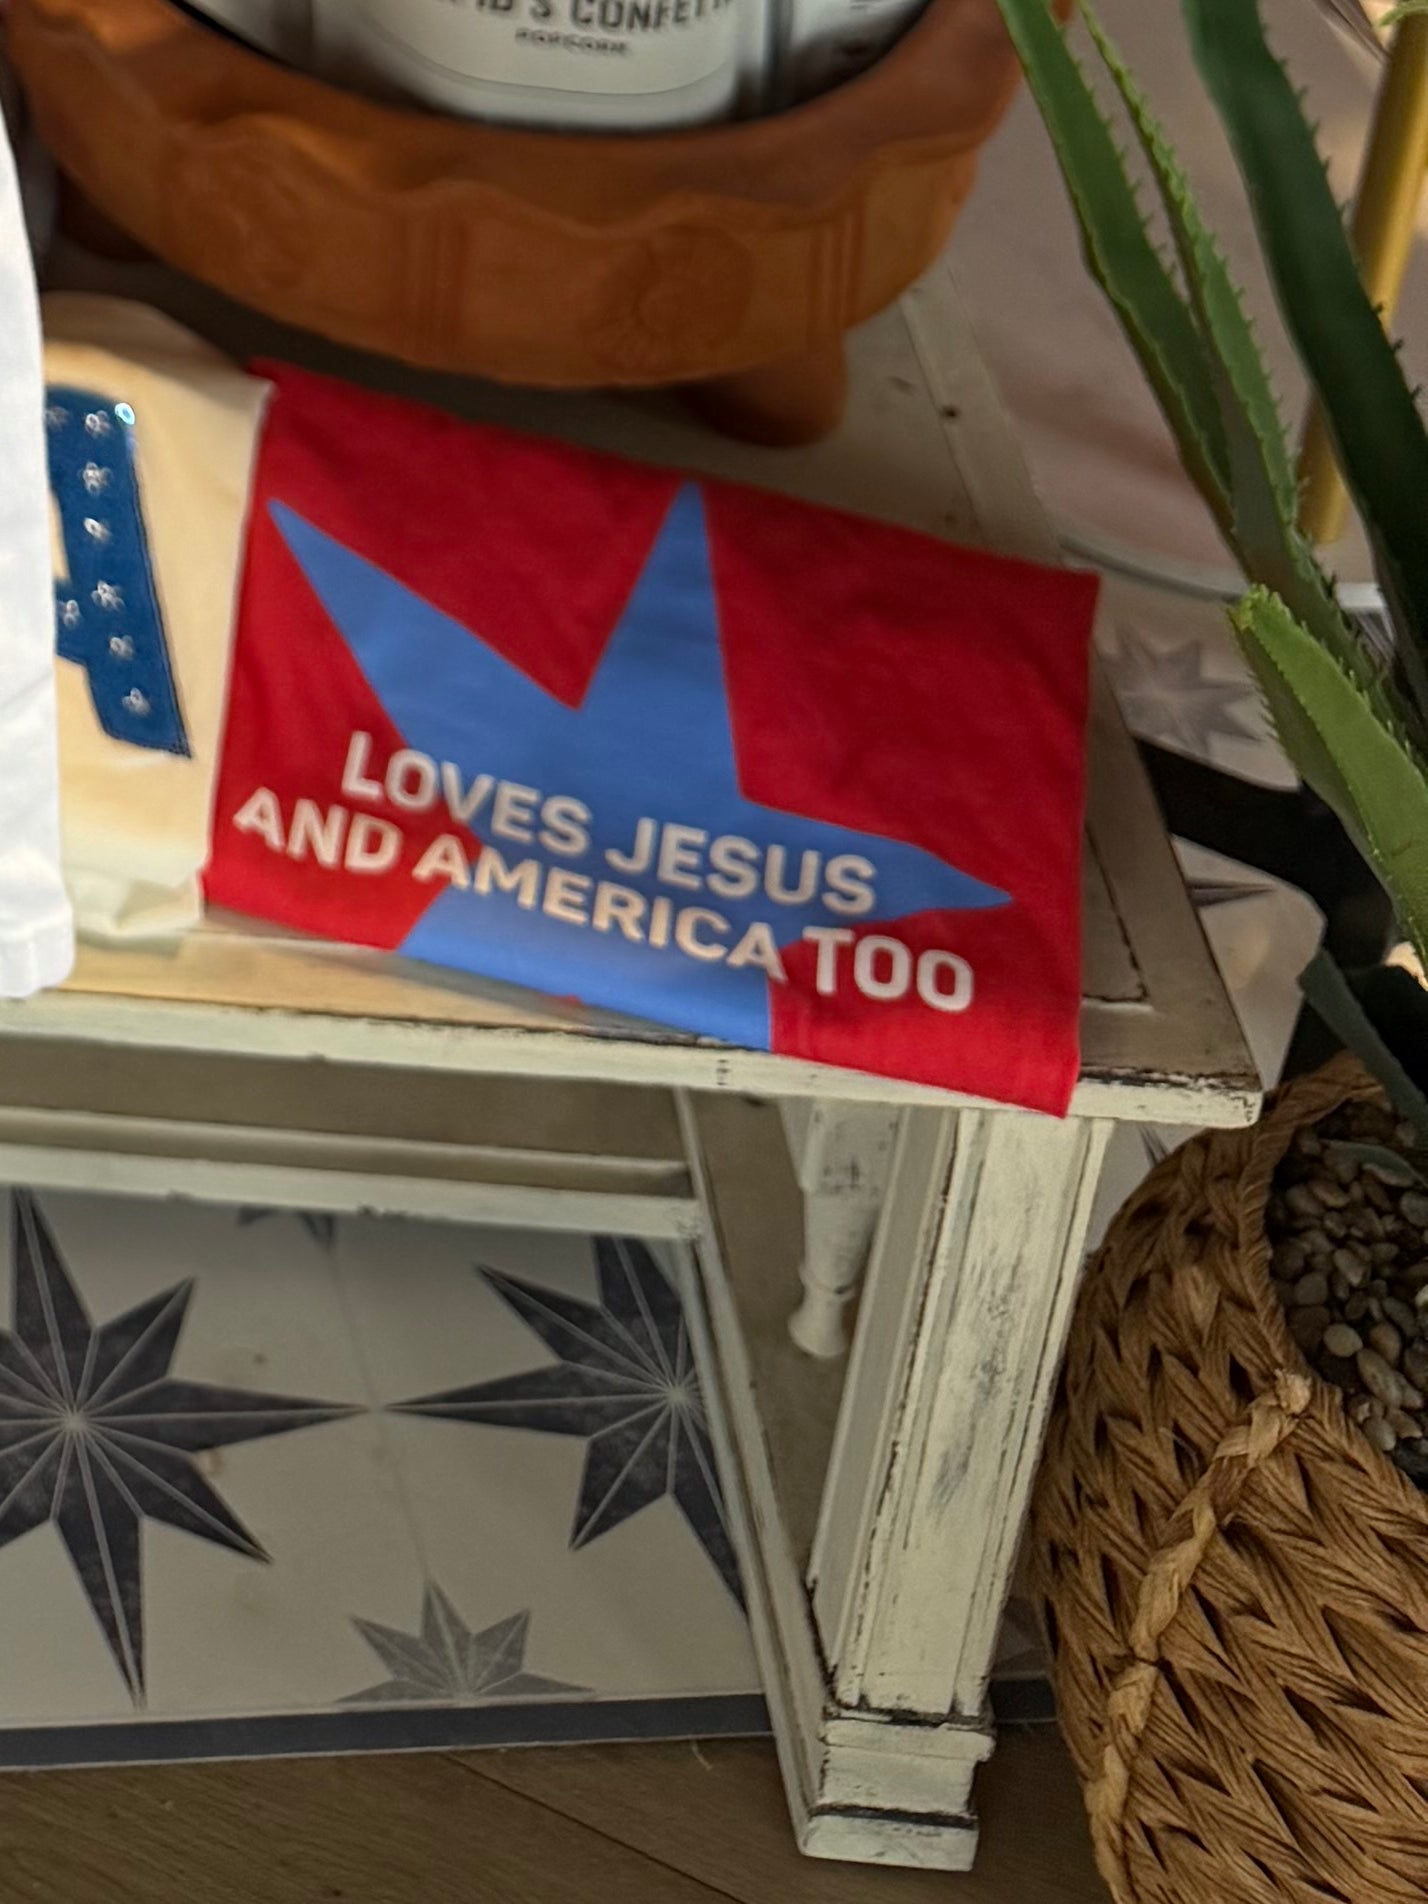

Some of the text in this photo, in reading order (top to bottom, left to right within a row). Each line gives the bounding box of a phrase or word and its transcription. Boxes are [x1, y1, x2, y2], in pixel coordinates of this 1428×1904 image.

[233, 787, 975, 1013] AND AMERICA TOO
[342, 731, 878, 916] LOVES JESUS
